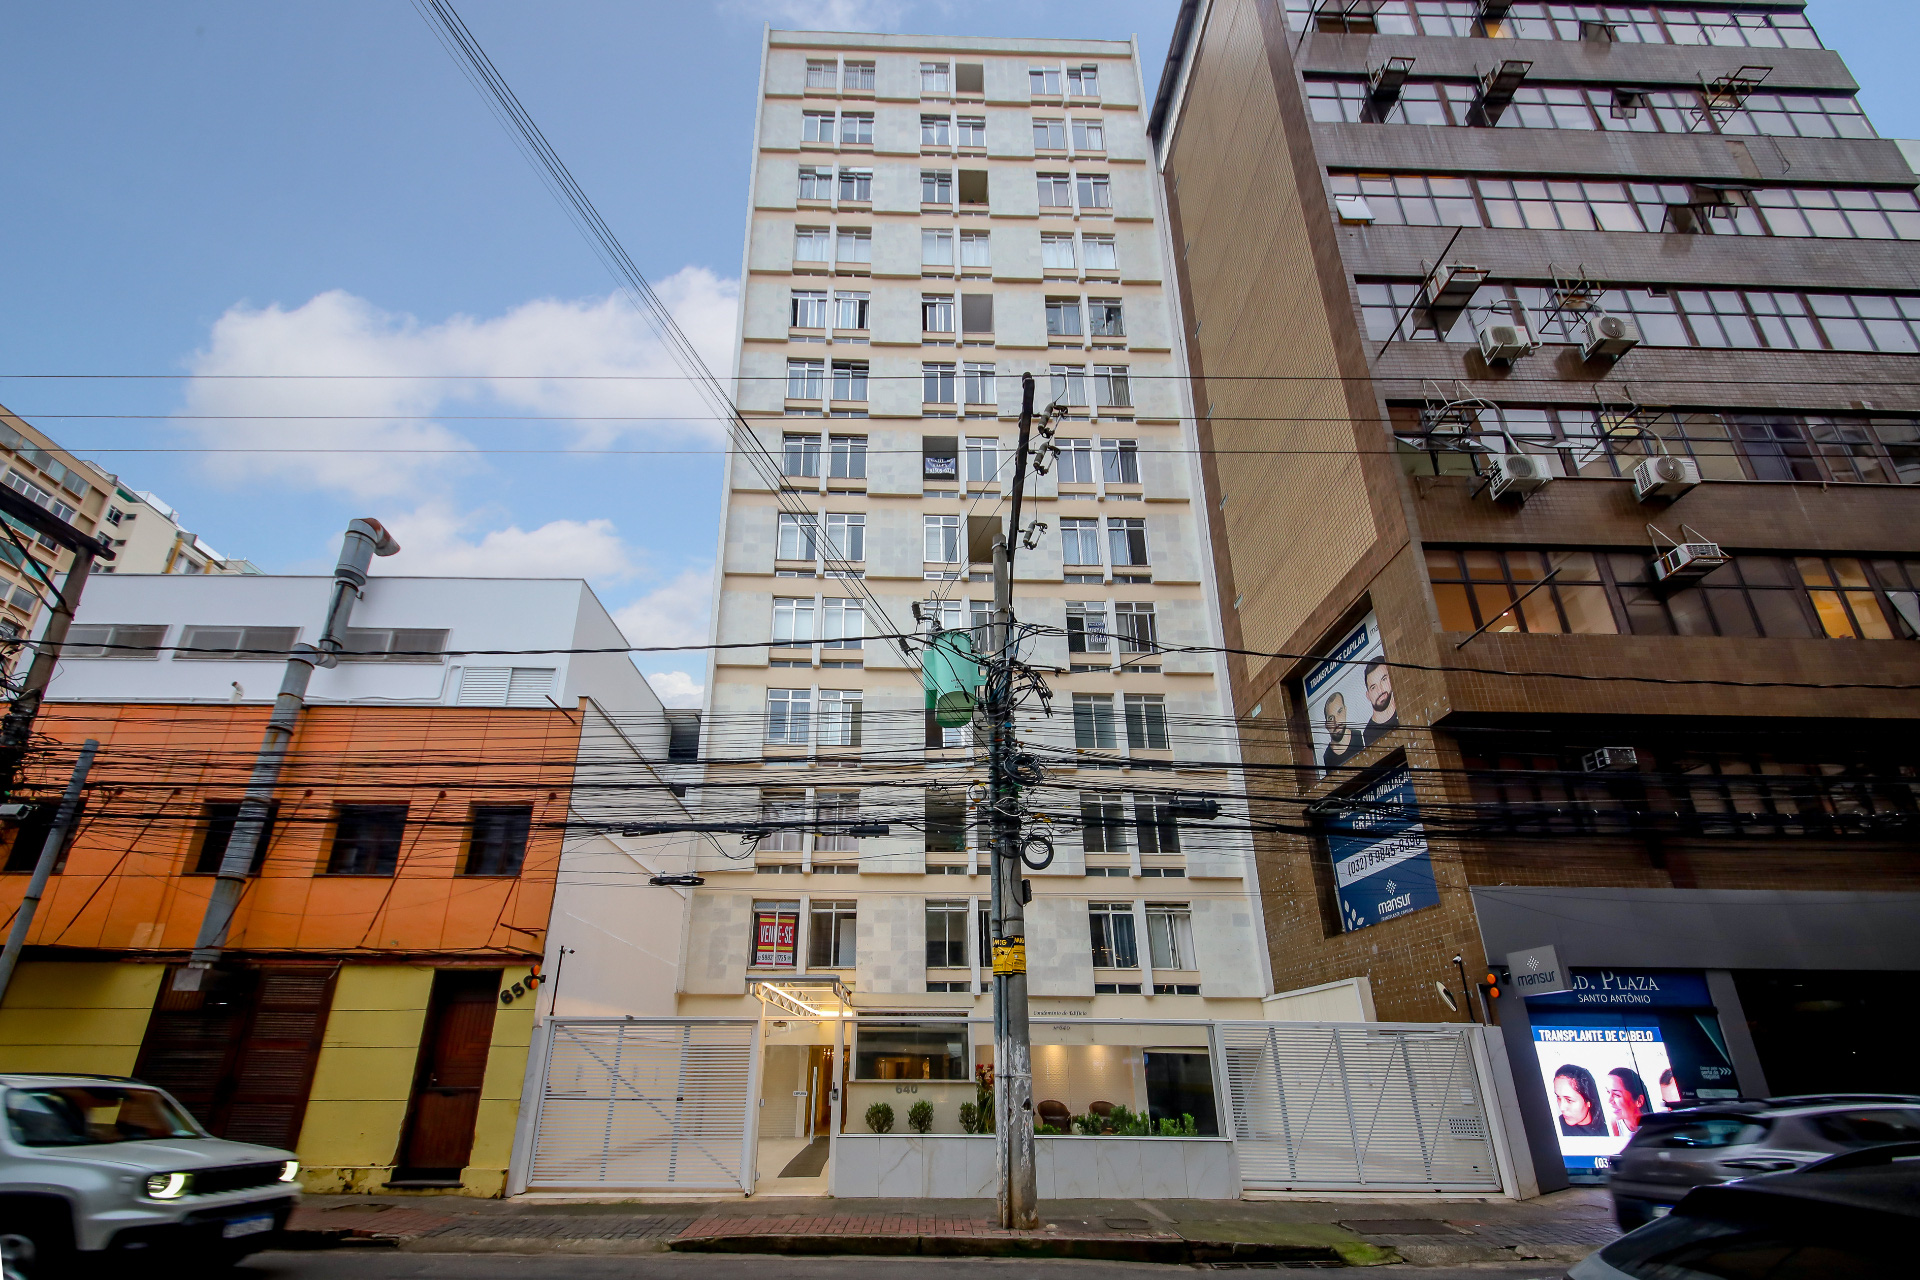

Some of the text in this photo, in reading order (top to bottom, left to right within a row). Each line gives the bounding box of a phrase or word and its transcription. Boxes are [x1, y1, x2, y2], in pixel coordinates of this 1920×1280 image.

[1342, 632, 1366, 659] CAPILAR
[1347, 854, 1368, 877] (032)
[1368, 853, 1374, 866] 9
[1378, 893, 1411, 914] mansur
[760, 925, 793, 944] VENE-SE
[1517, 970, 1555, 987] mansur
[1572, 975, 1596, 990] D.
[1577, 992, 1651, 1004] SANTO ANTÔNIO
[1538, 1029, 1654, 1042] TRANSPLANTE DE CABELO
[895, 1084, 918, 1094] 640
[1594, 1156, 1611, 1169] (03
